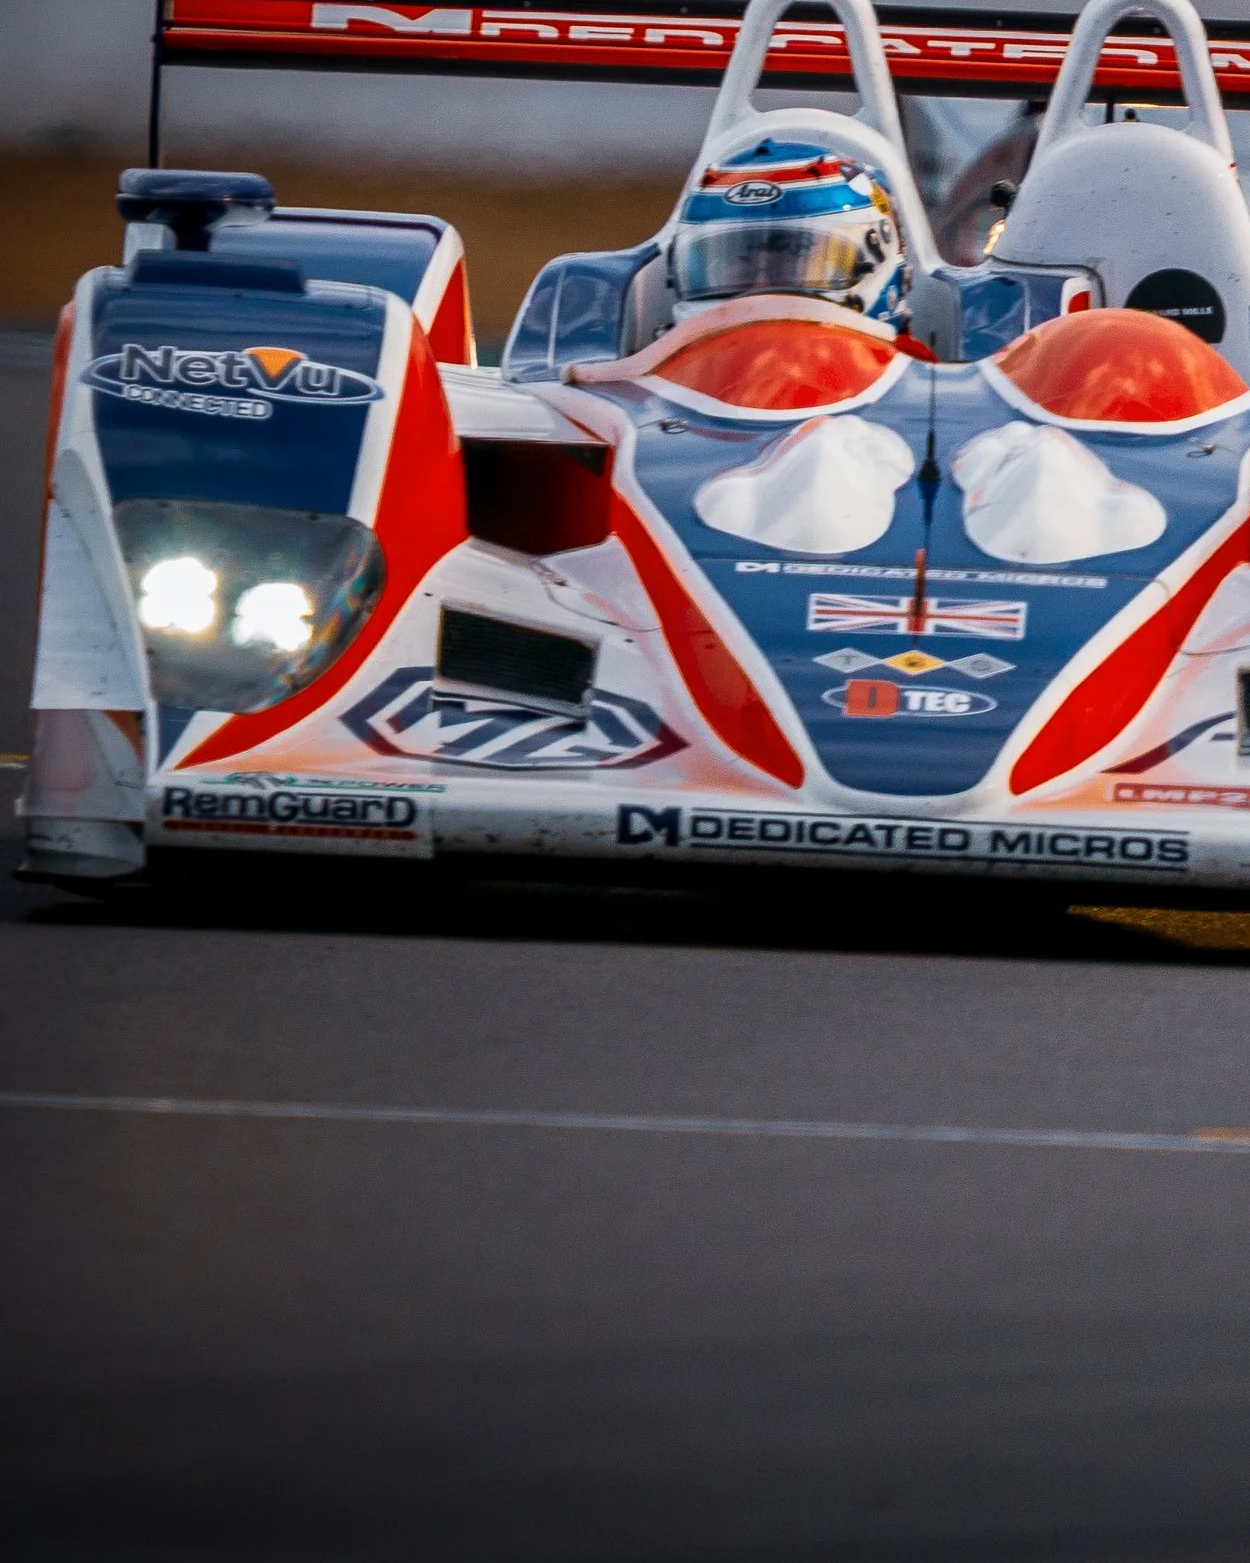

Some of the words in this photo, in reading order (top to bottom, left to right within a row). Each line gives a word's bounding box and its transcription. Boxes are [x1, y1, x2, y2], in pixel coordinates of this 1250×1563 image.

[480, 21, 1157, 65] DEDCTED
[123, 383, 273, 420] CONNECTED
[690, 814, 970, 853] DEDICATED
[989, 827, 1190, 864] MICROS
